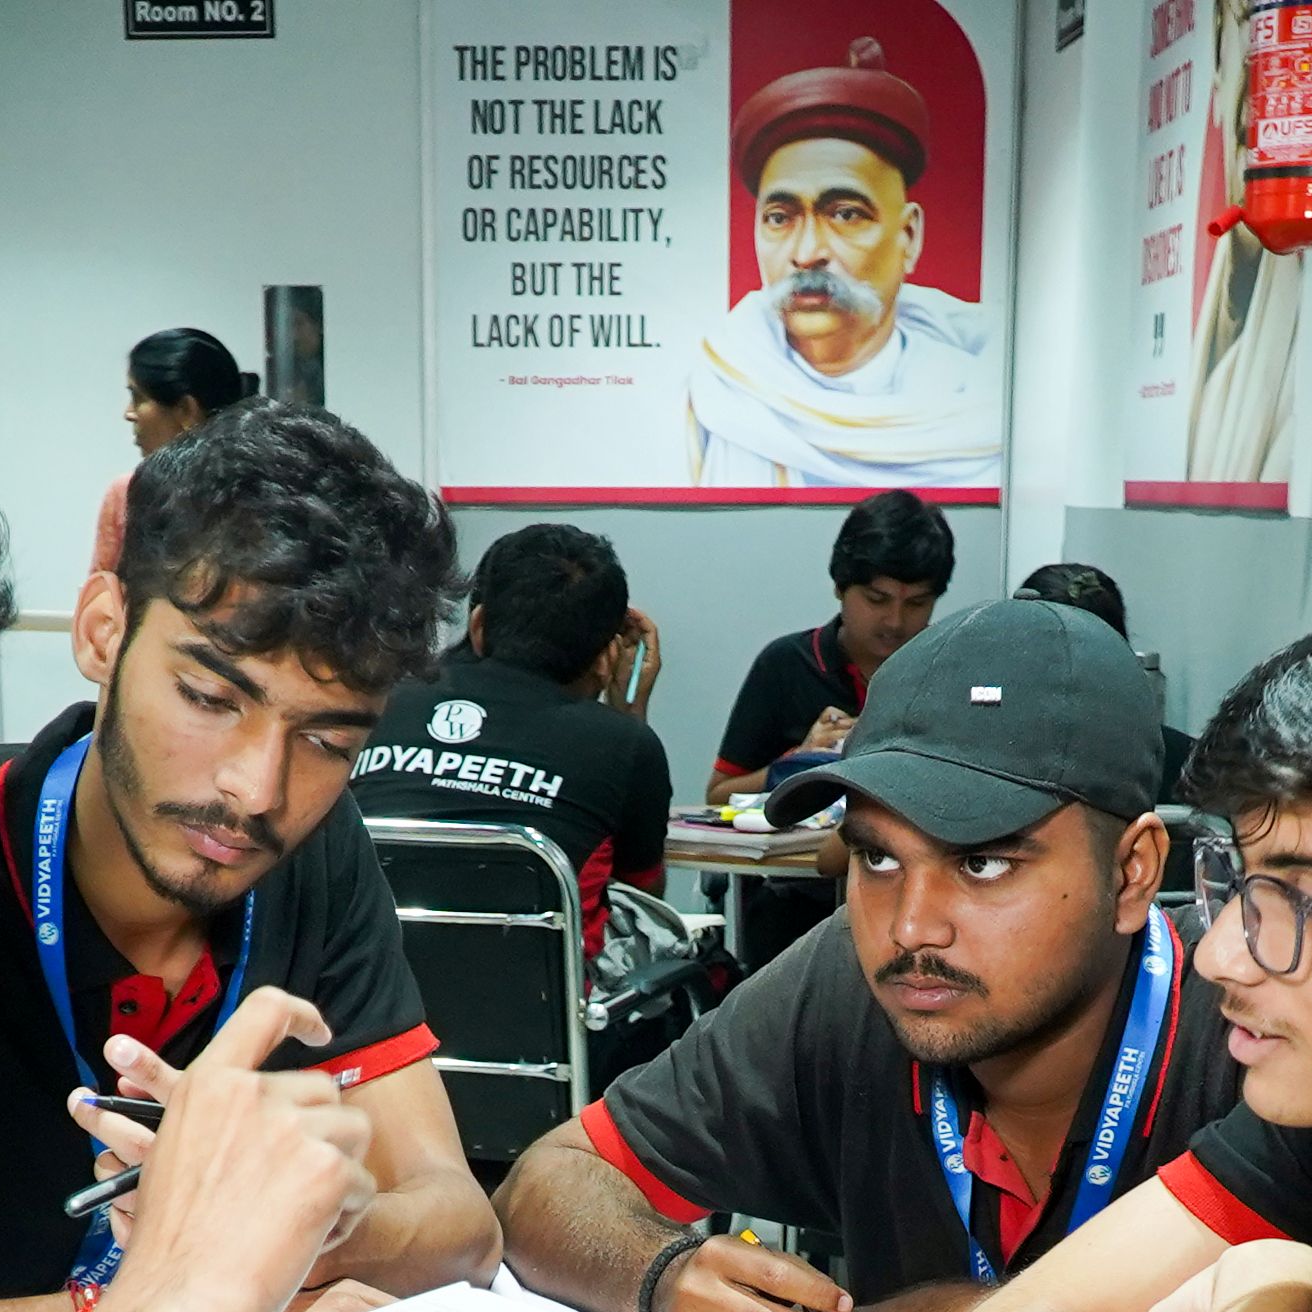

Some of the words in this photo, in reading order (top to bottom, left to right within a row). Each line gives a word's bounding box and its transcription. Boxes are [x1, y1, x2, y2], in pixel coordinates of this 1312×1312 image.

[135, 1, 199, 22] Room
[204, 0, 244, 22] NO.
[250, 1, 265, 22] 2
[453, 45, 506, 81] THE
[514, 45, 644, 81] PROBLEM
[654, 45, 678, 82] IS
[470, 99, 525, 135] NOT
[532, 99, 585, 135] THE
[593, 99, 663, 135] LACK
[467, 154, 500, 190] OF
[509, 154, 667, 190] RESOURCES
[462, 207, 496, 243] OR
[505, 207, 672, 249] CAPABILITY,
[511, 262, 563, 296] BUT
[571, 262, 623, 296] THE
[472, 313, 540, 348] LACK
[548, 313, 582, 348] OF
[590, 313, 662, 348] WILL.
[508, 375, 527, 386] Bal
[531, 375, 602, 389] Gangadhar
[605, 375, 635, 386] Tilak
[430, 777, 501, 797] PATHSHALA
[501, 788, 554, 809] CENTRE
[37, 798, 58, 919] VIDYAPEETH
[1092, 1047, 1140, 1161] VIDYAPEETH
